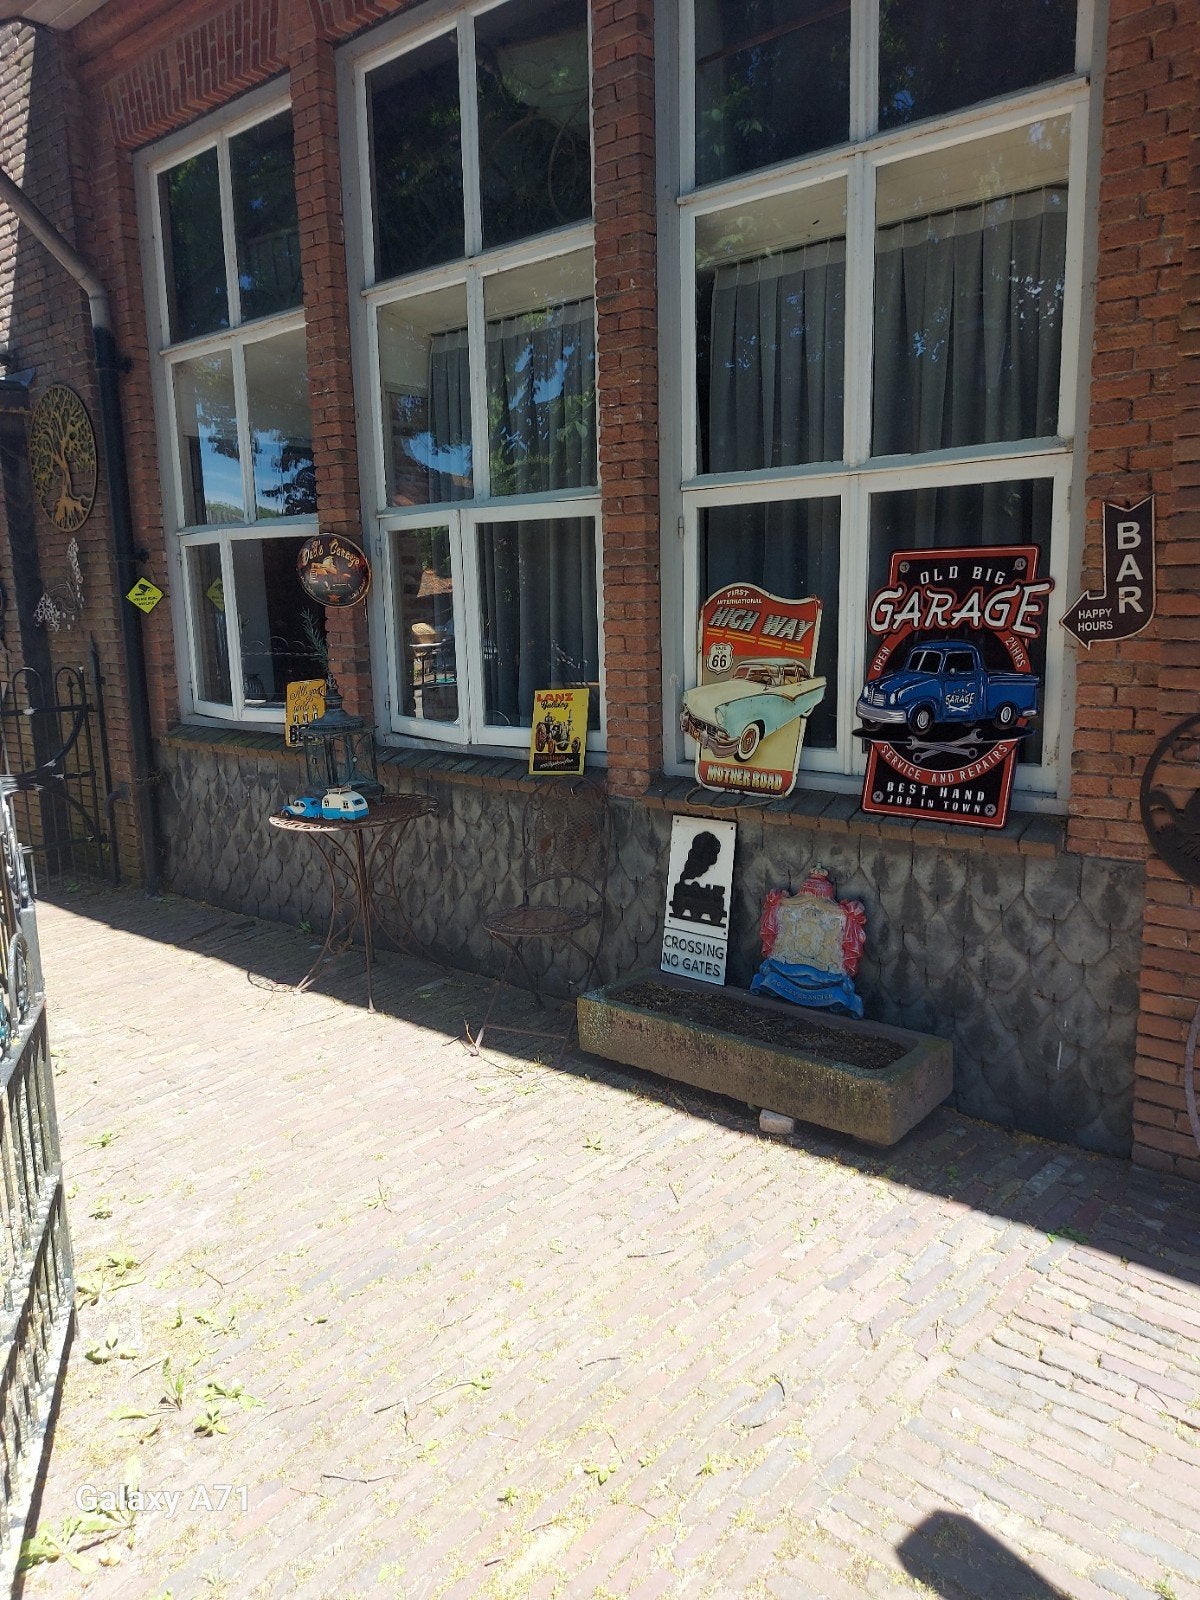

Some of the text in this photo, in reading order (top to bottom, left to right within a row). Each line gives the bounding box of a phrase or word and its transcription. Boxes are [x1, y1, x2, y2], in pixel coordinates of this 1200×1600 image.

[920, 566, 1006, 585] OLD BIG
[1115, 521, 1144, 614] BAR
[727, 589, 750, 598] FIRST
[871, 583, 1050, 634] GARAGE
[1078, 608, 1112, 620] HAPPY
[708, 606, 814, 641] HIGH WAY
[1077, 621, 1113, 632] HOURS
[712, 654, 727, 668] 66
[873, 646, 890, 672] OPEN
[1005, 636, 1027, 669] 24HRS
[536, 692, 574, 702] LANZ
[945, 692, 976, 705] GARAGE
[882, 744, 1008, 783] SERVICE AND REPAIRS
[707, 764, 783, 791] MOTHER ROAD
[887, 781, 985, 801] BEST HAND
[888, 794, 981, 813] JOB IN TOWN
[664, 934, 724, 960] CROSSING
[663, 952, 721, 977] NO GATES
